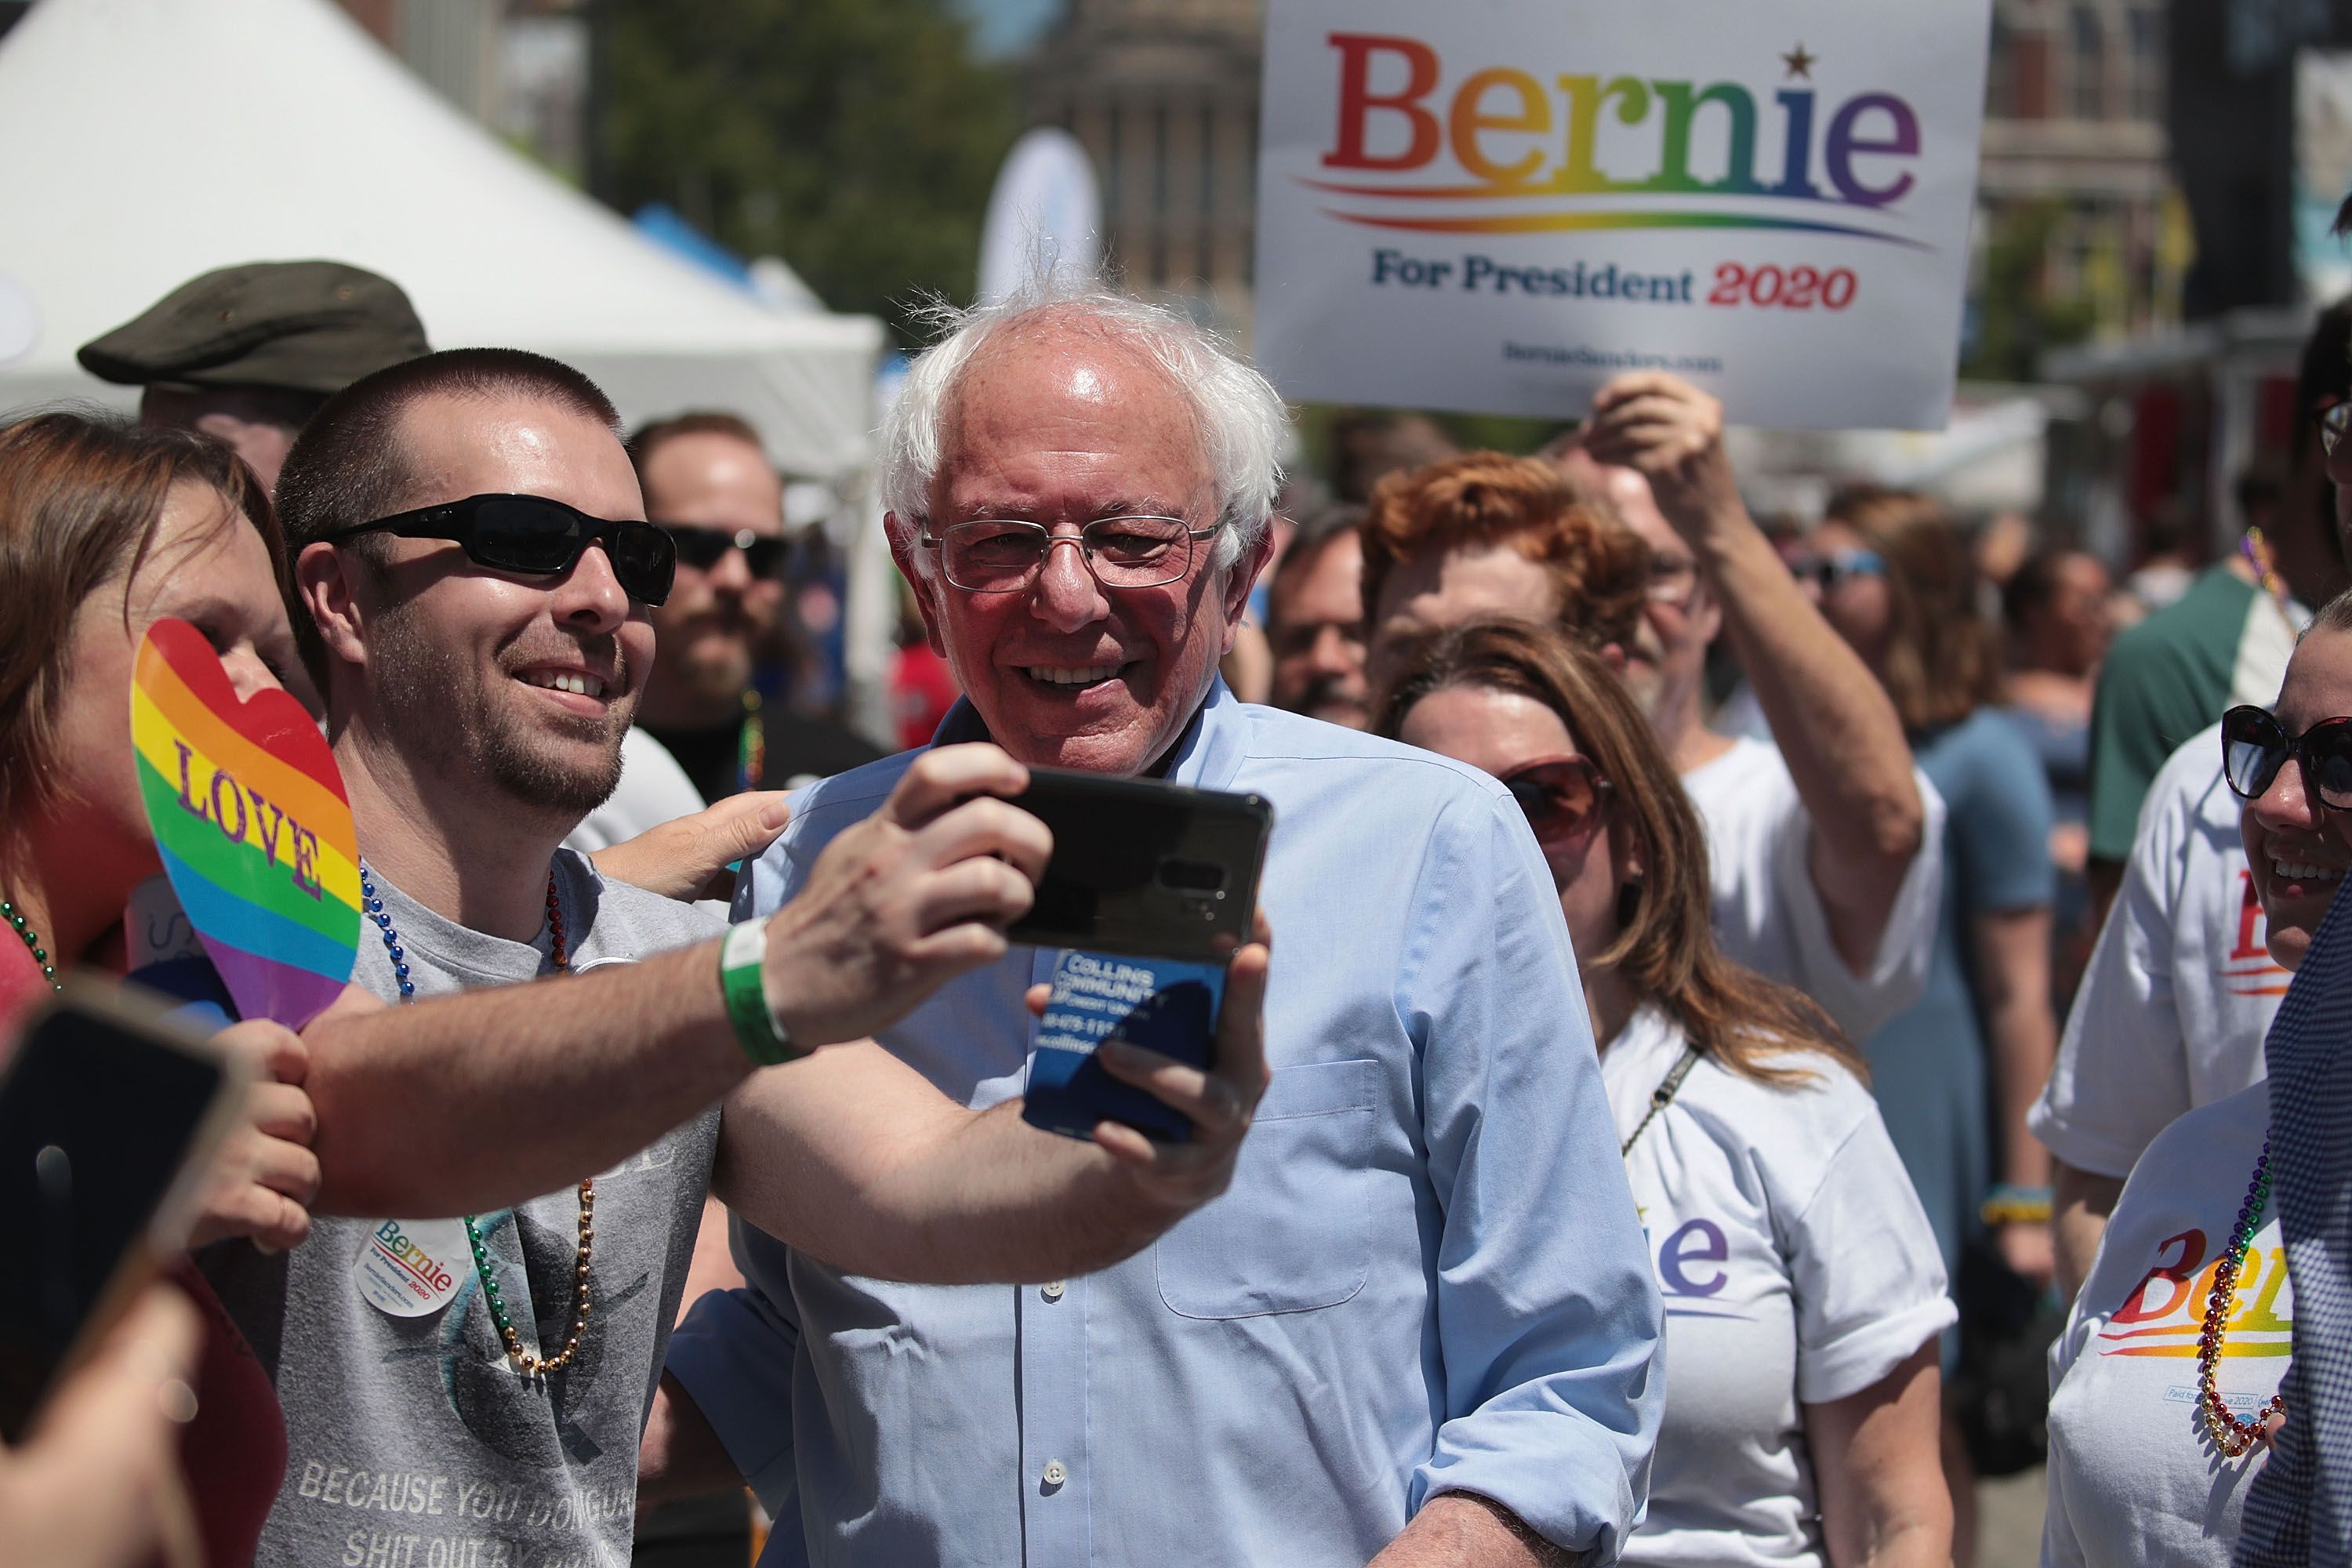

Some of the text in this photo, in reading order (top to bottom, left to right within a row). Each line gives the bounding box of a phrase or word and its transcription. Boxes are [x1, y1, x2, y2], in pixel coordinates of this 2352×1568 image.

[1319, 31, 1922, 209] Bernie
[1370, 249, 1859, 310] For President 2020
[174, 739, 322, 902] LOVE
[370, 1247, 381, 1258] For
[380, 1255, 409, 1283] President
[408, 1281, 430, 1300] 2020
[376, 1218, 452, 1292] Bernie
[2169, 1388, 2185, 1399] Paid
[2234, 1396, 2253, 1406] 2020
[299, 1459, 448, 1515] BECAUSE
[458, 1481, 525, 1521] YOU
[342, 1530, 420, 1568] SHIT
[427, 1537, 486, 1568] OUT
